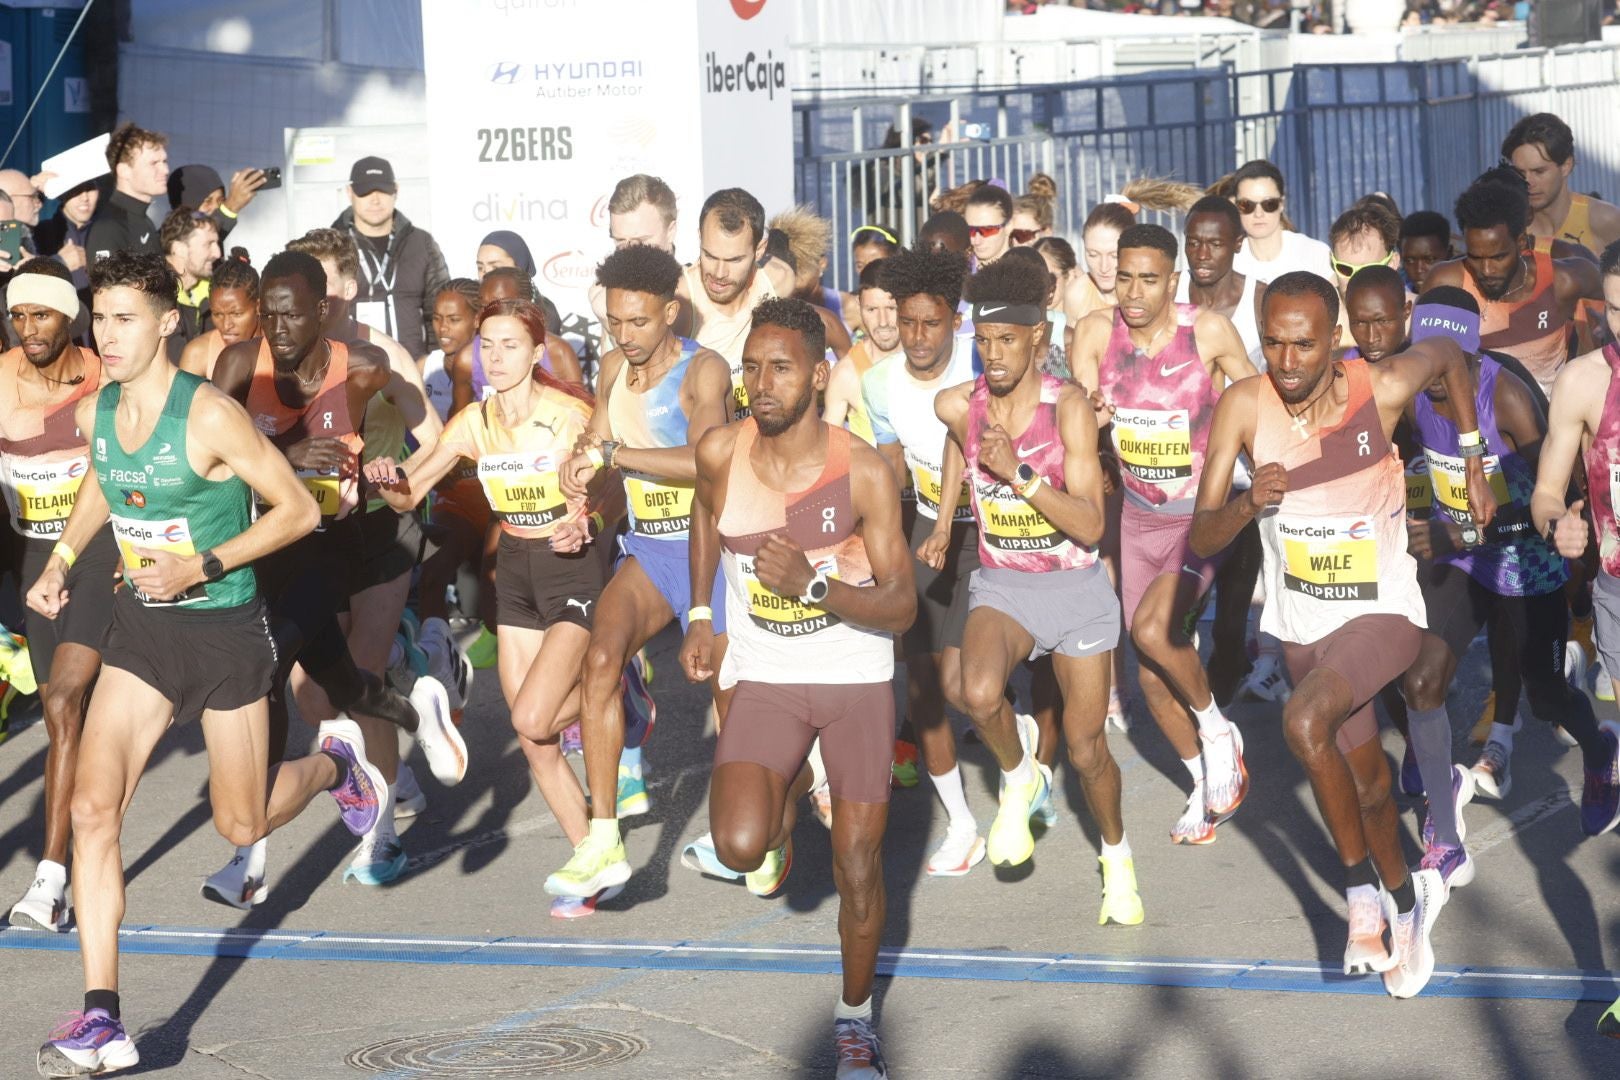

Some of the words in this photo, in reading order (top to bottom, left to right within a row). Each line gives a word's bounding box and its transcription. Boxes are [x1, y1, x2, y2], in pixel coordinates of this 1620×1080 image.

[534, 60, 643, 80] HYUNDAI
[706, 49, 785, 101] iberCaja
[537, 85, 592, 98] Autiber
[596, 84, 643, 97] Motor
[477, 126, 573, 162] 226ERS
[472, 193, 568, 223] divina
[1421, 317, 1468, 335] KIPRUN
[1120, 439, 1190, 456] OUKHELFEN
[481, 460, 524, 472] iberCaja
[1150, 457, 1158, 466] 19
[12, 469, 57, 481] iberCaja
[110, 469, 147, 484] Facsa
[1129, 465, 1177, 479] KIPRUN
[505, 486, 546, 502] LUKAN
[645, 490, 679, 507] GIDEY
[506, 511, 553, 525] KIPRUN
[661, 507, 671, 518] 16
[991, 513, 1046, 527] MAHAME
[642, 517, 691, 534] KIPRUN
[1019, 528, 1031, 537] 35
[1279, 523, 1335, 539] iberCaja
[1498, 521, 1529, 533] KIPRUN
[999, 537, 1052, 549] KIPRUN
[1310, 554, 1352, 571] WALE
[1328, 573, 1336, 583] 11
[1300, 582, 1359, 599] KIPRUN
[793, 610, 804, 620] 13
[766, 617, 828, 635] KIPRUN
